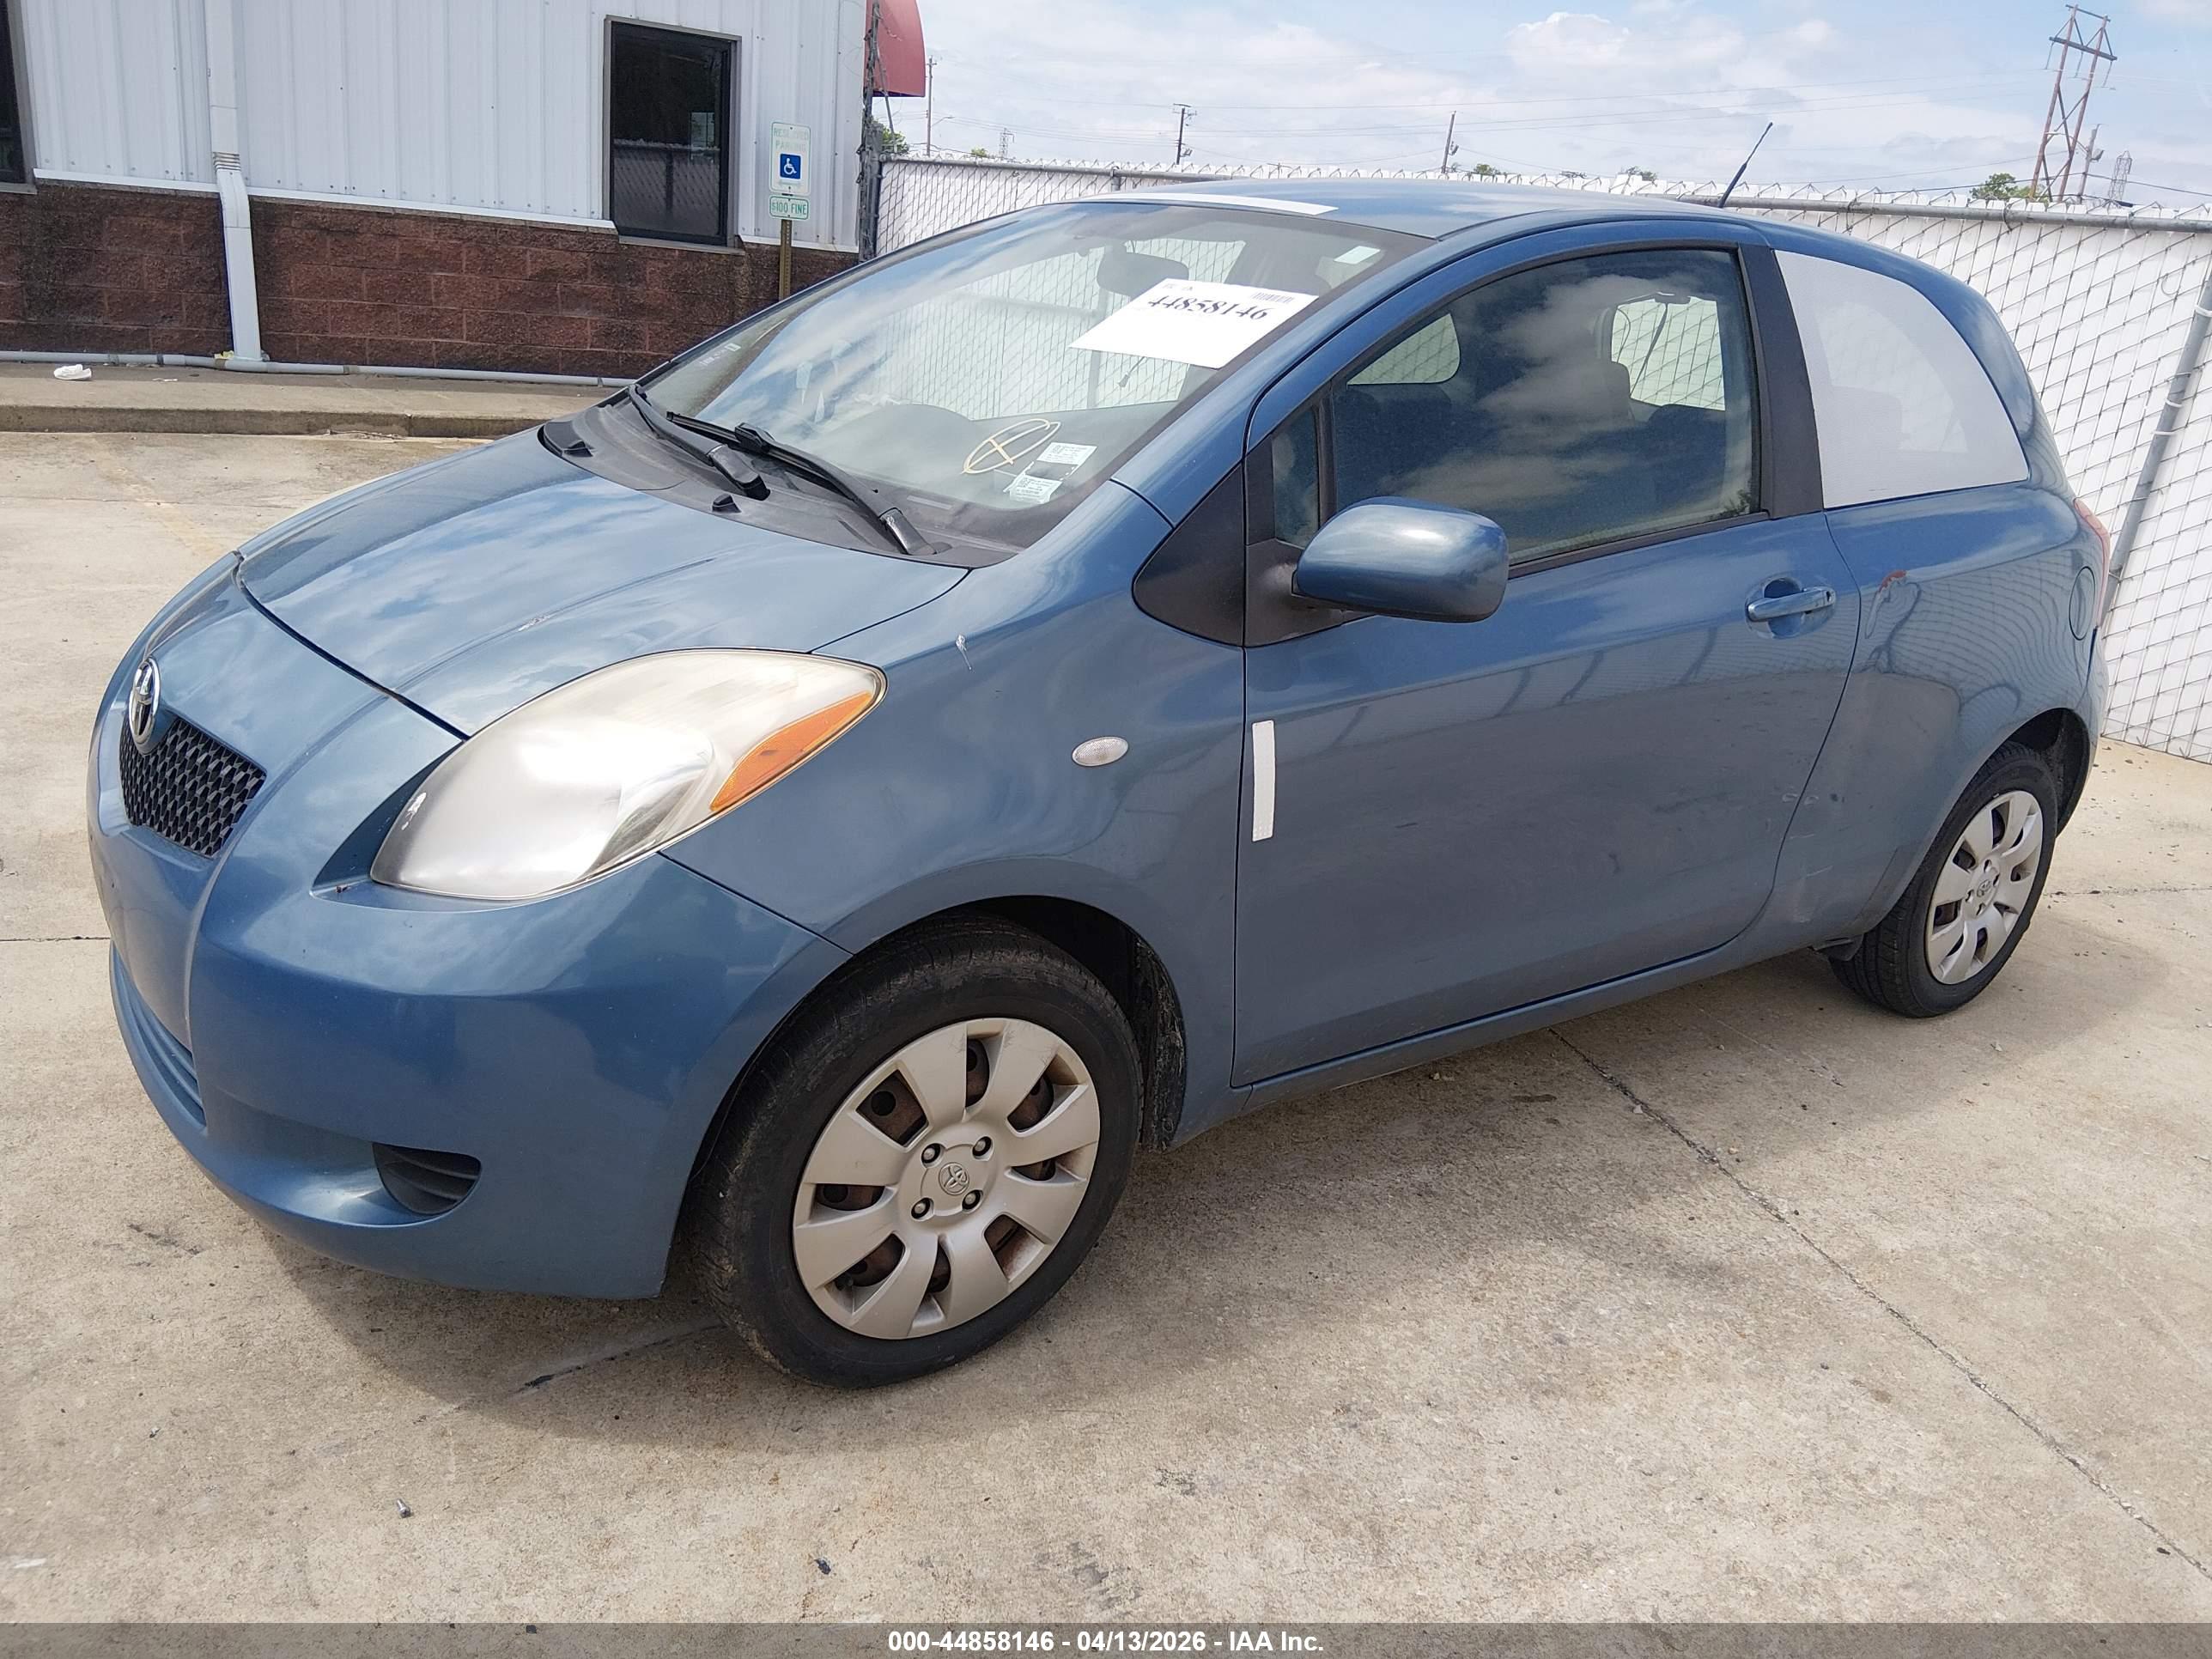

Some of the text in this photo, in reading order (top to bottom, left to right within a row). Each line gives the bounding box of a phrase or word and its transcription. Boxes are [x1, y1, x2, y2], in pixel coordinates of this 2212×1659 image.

[774, 128, 809, 140] RESED
[775, 140, 806, 152] PARNG
[791, 203, 807, 215] FINE
[1148, 295, 1271, 320] 44858146
